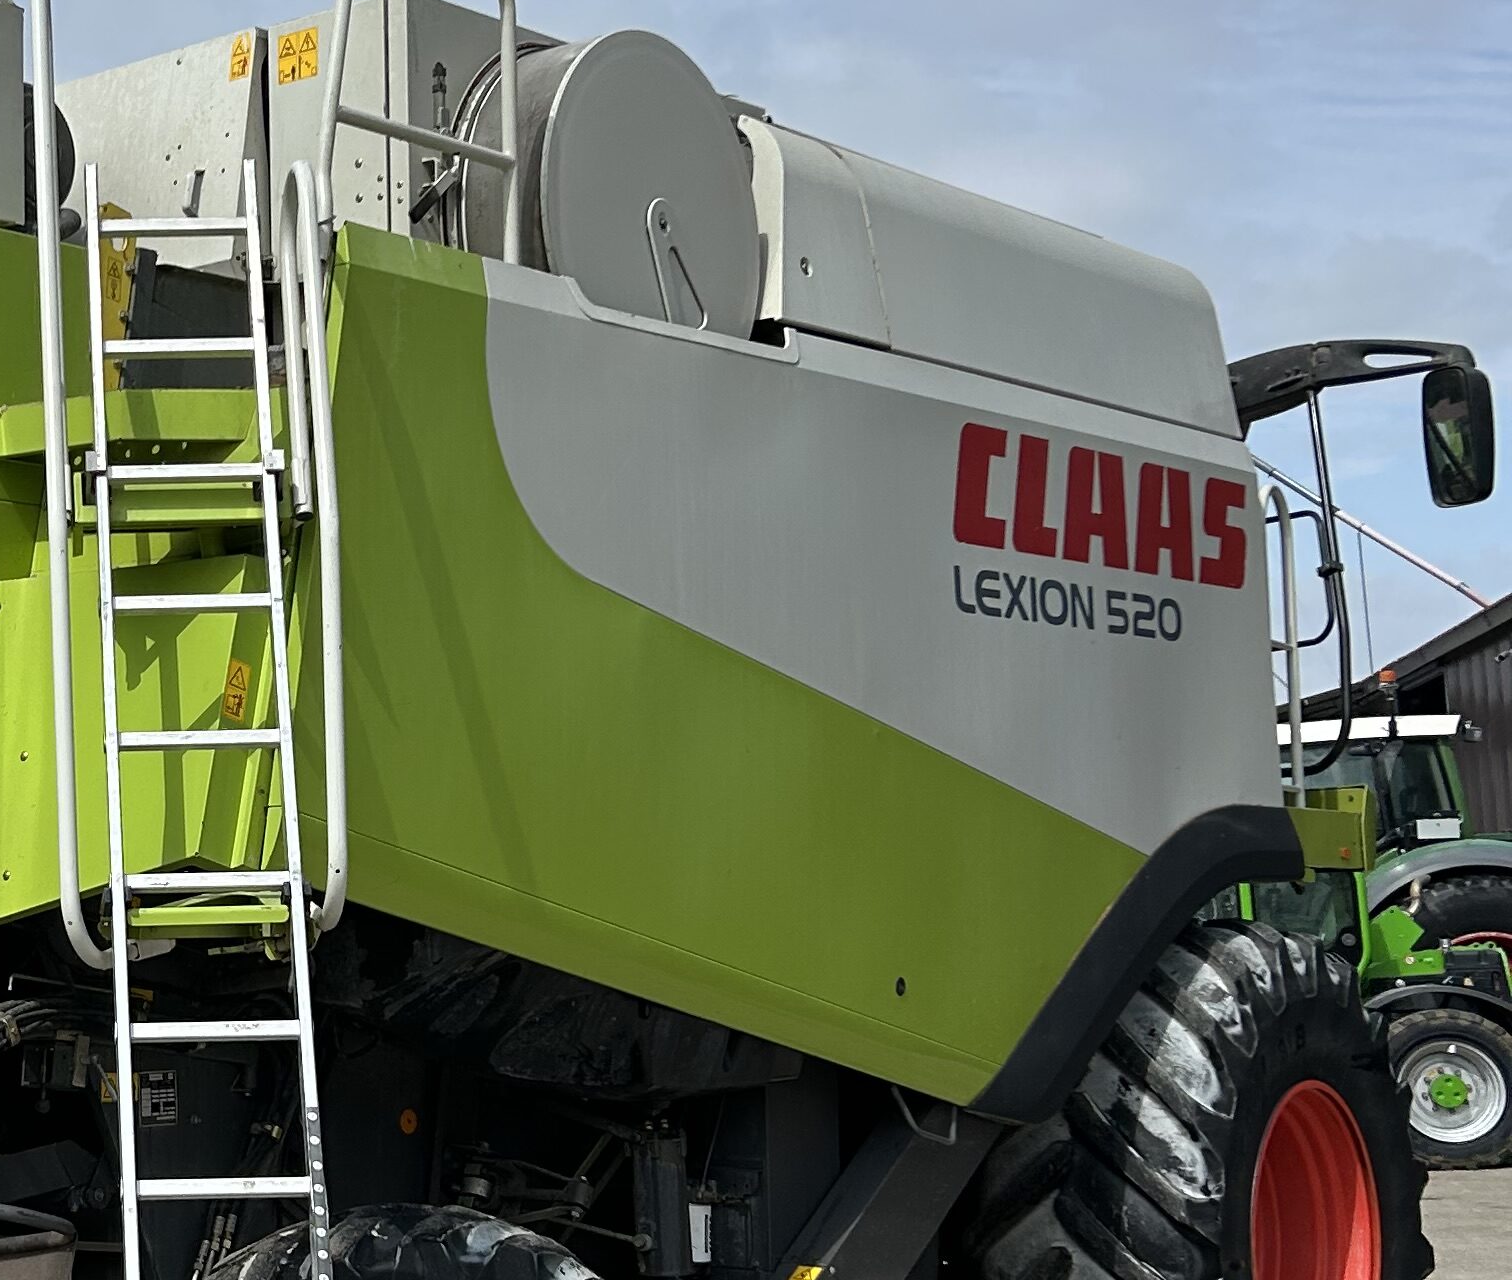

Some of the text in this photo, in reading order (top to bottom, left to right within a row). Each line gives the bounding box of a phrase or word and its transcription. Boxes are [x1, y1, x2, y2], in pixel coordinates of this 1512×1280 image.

[953, 422, 1246, 589] CLAAS
[953, 565, 1182, 642] LEXION 520
